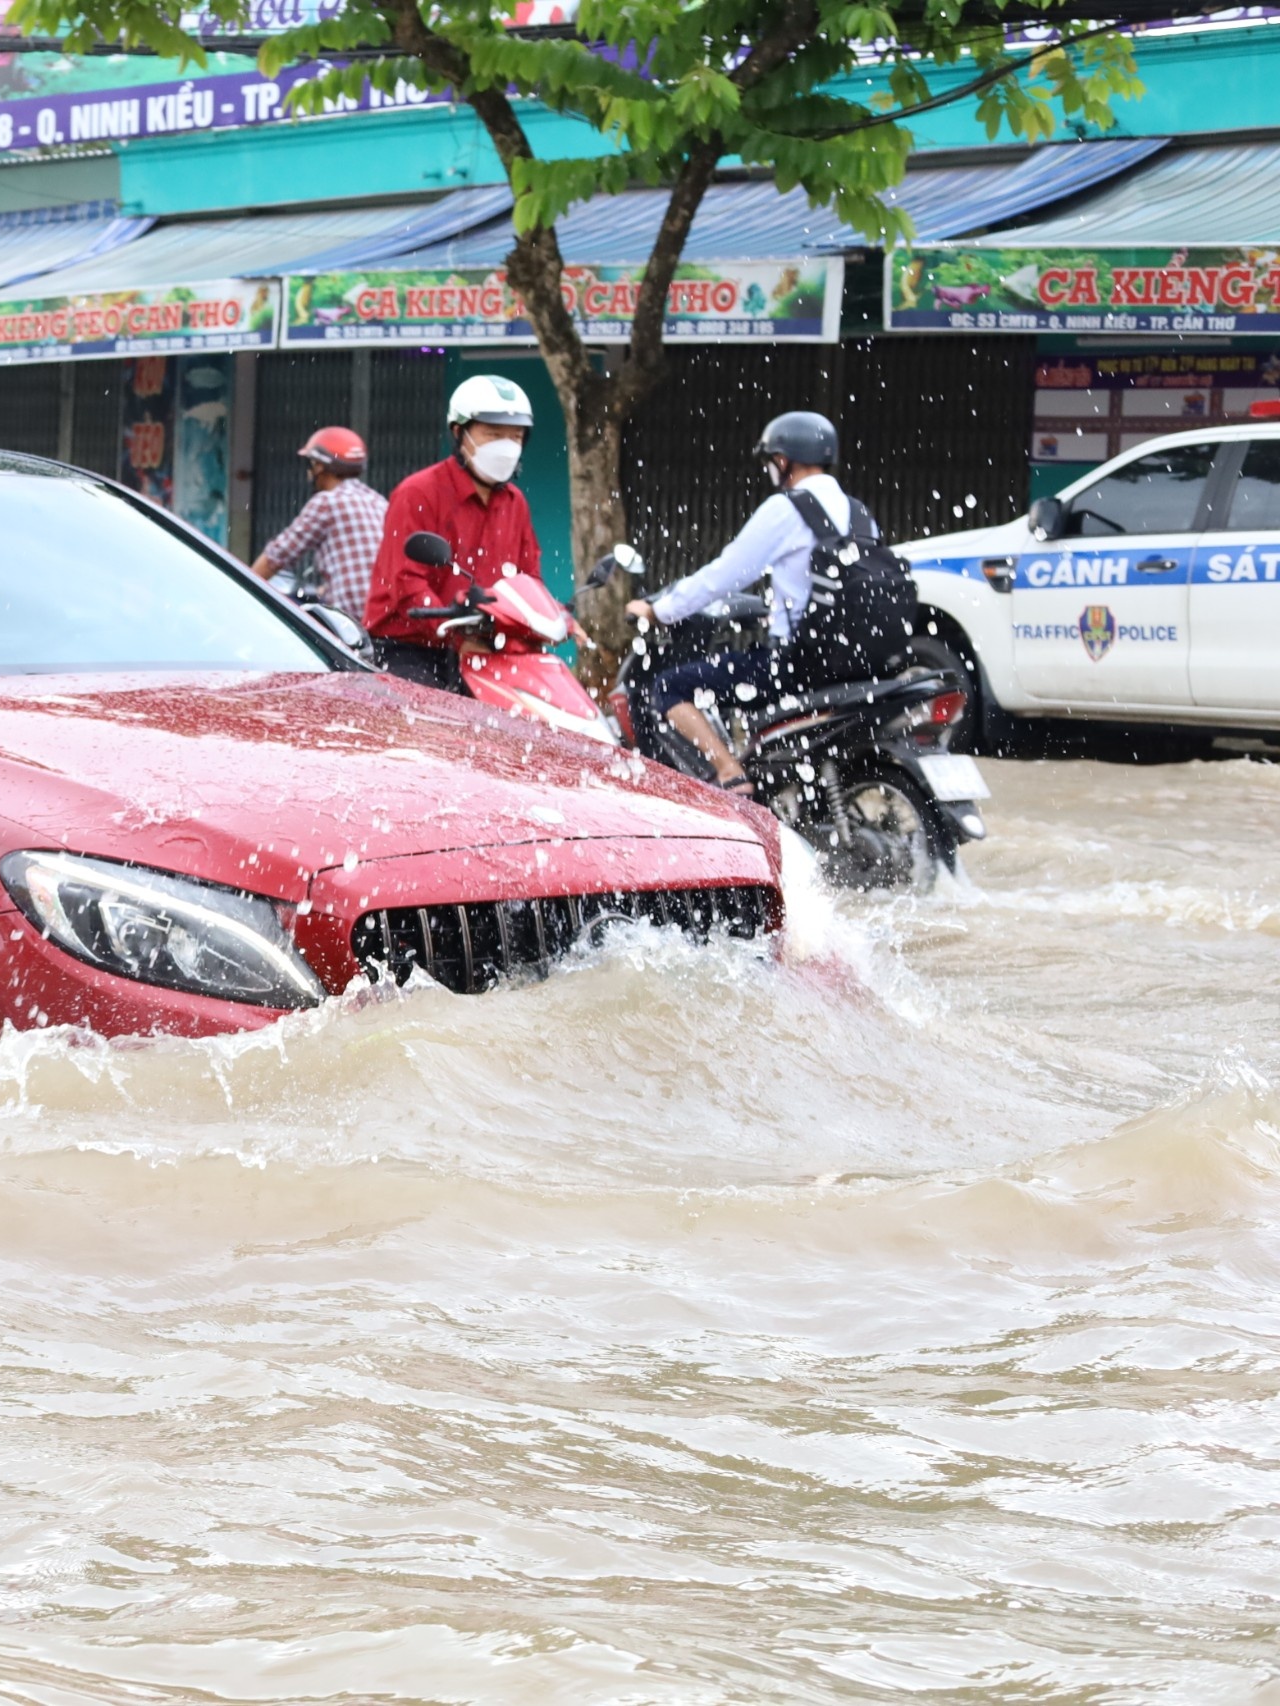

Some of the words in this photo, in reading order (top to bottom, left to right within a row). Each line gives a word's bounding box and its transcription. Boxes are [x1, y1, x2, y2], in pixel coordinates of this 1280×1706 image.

[37, 107, 64, 145] Q.
[70, 98, 140, 141] NINH
[146, 80, 214, 133] KIỀU
[241, 82, 284, 121] TP.
[977, 313, 997, 328] 53
[999, 314, 1038, 329] CMT8
[1066, 316, 1101, 329] NINH
[1150, 316, 1170, 330] TP.
[1208, 315, 1237, 330] THƠ
[1027, 552, 1129, 587] CẢNH
[1207, 545, 1280, 582] SÁT
[1013, 624, 1079, 640] TRAFFIC
[1119, 626, 1177, 641] POLICE
